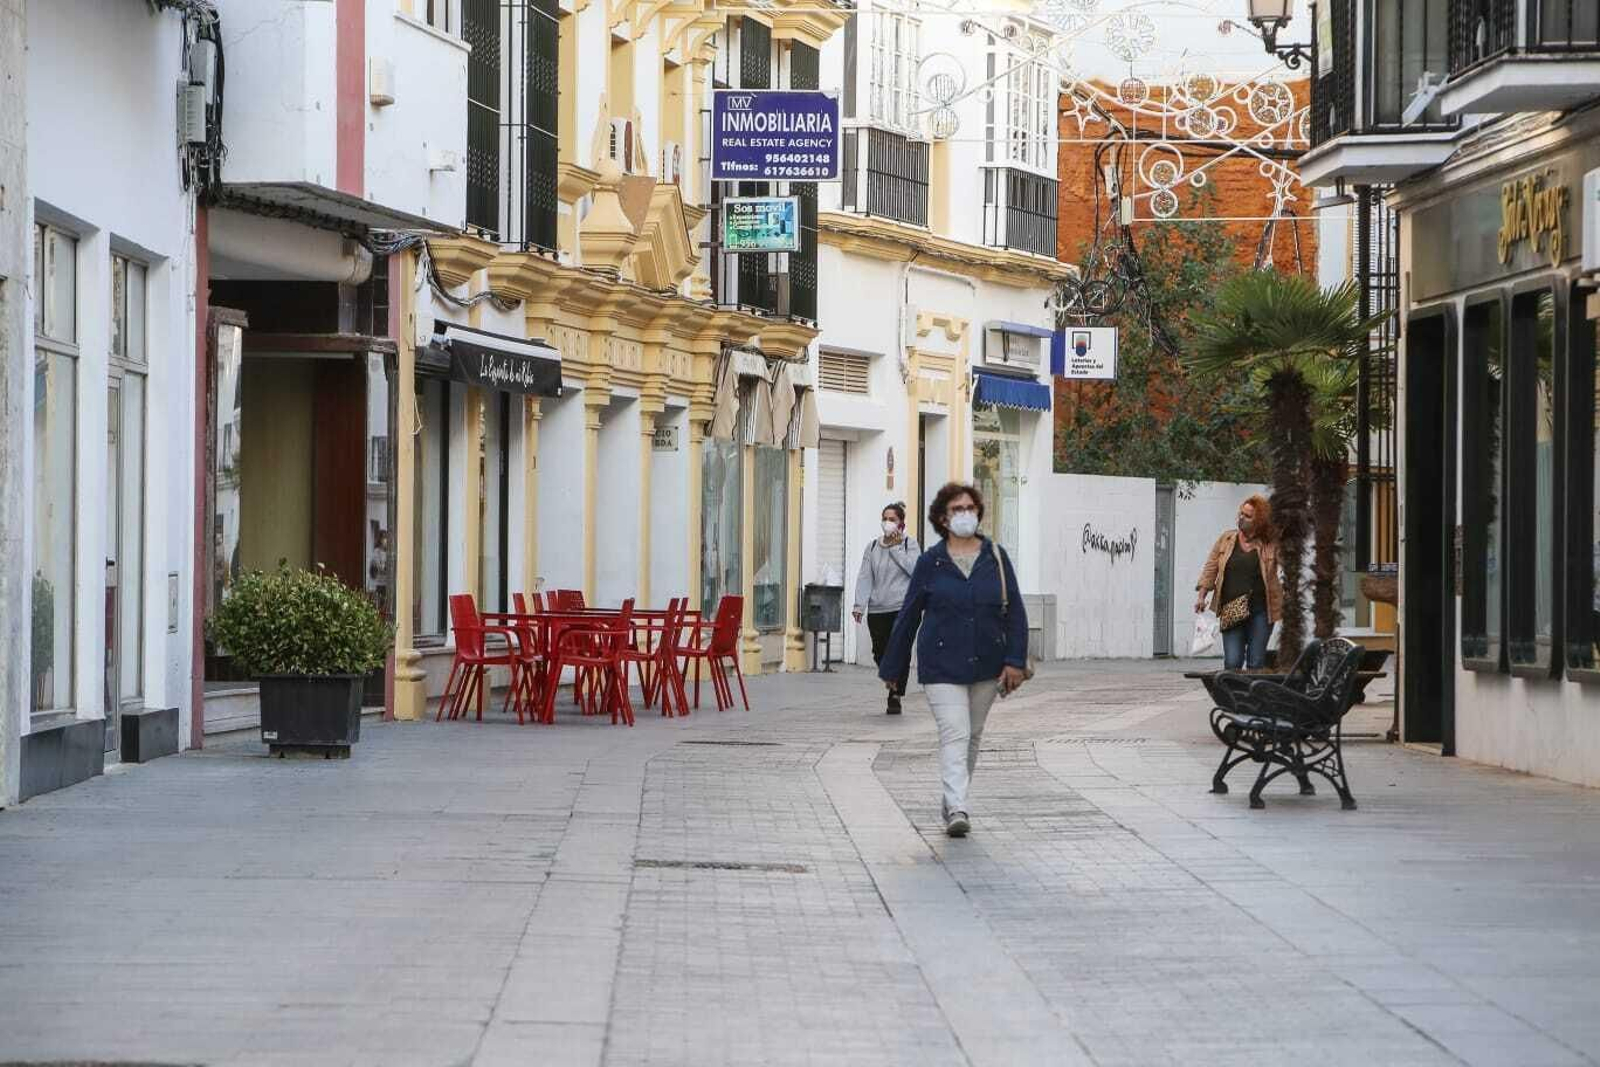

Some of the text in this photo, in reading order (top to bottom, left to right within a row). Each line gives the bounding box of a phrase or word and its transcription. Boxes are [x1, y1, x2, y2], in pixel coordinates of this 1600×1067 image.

[731, 98, 751, 108] MV
[722, 112, 833, 133] INMOBILIARIA
[722, 138, 833, 148] REAL ESTATE AGENCY
[765, 154, 830, 163] 956402148
[764, 167, 829, 176] 617636610
[733, 204, 753, 214] Sos
